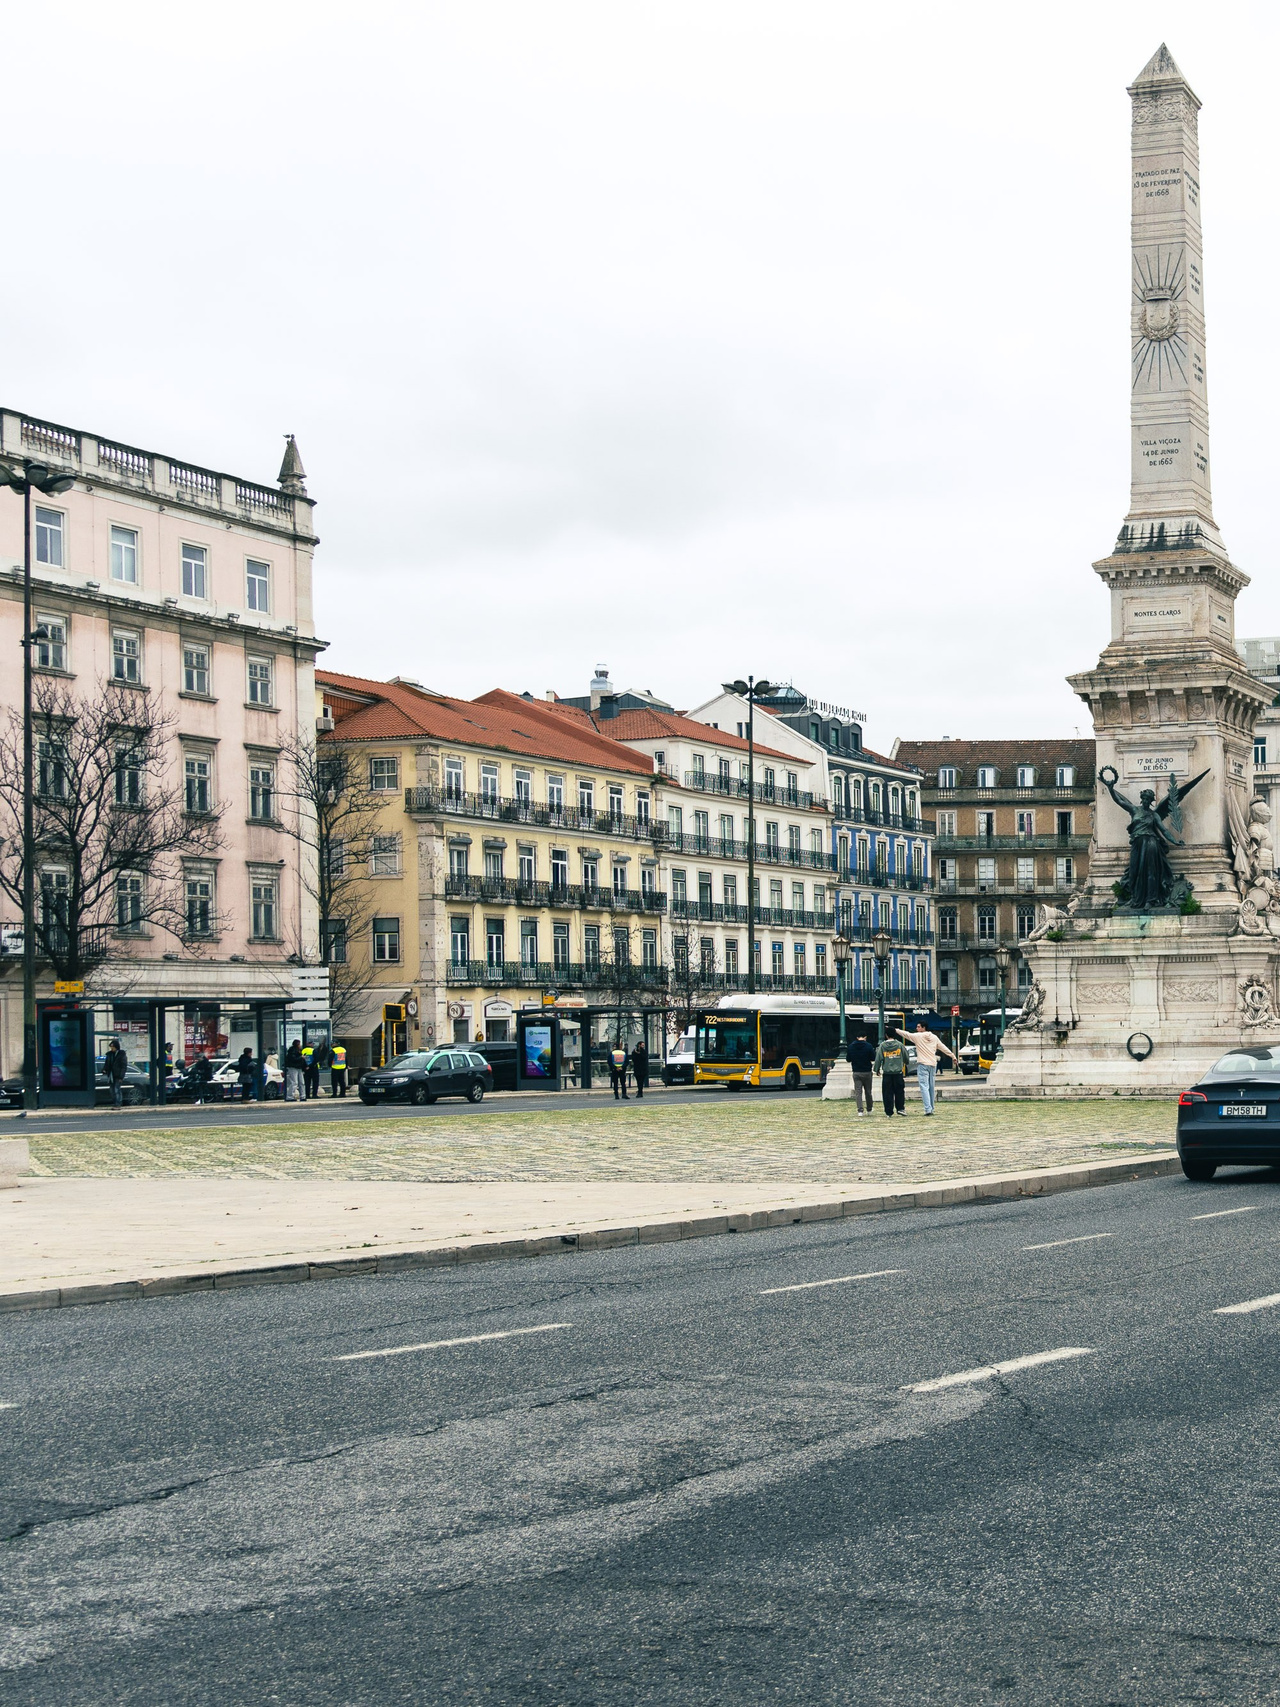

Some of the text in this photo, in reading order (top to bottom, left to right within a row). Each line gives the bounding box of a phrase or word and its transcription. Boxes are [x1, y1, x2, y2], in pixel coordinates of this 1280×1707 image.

[1135, 170, 1160, 178] TRATADO
[1155, 188, 1169, 196] 1668
[1159, 458, 1173, 466] 1665
[705, 1016, 717, 1024] 722
